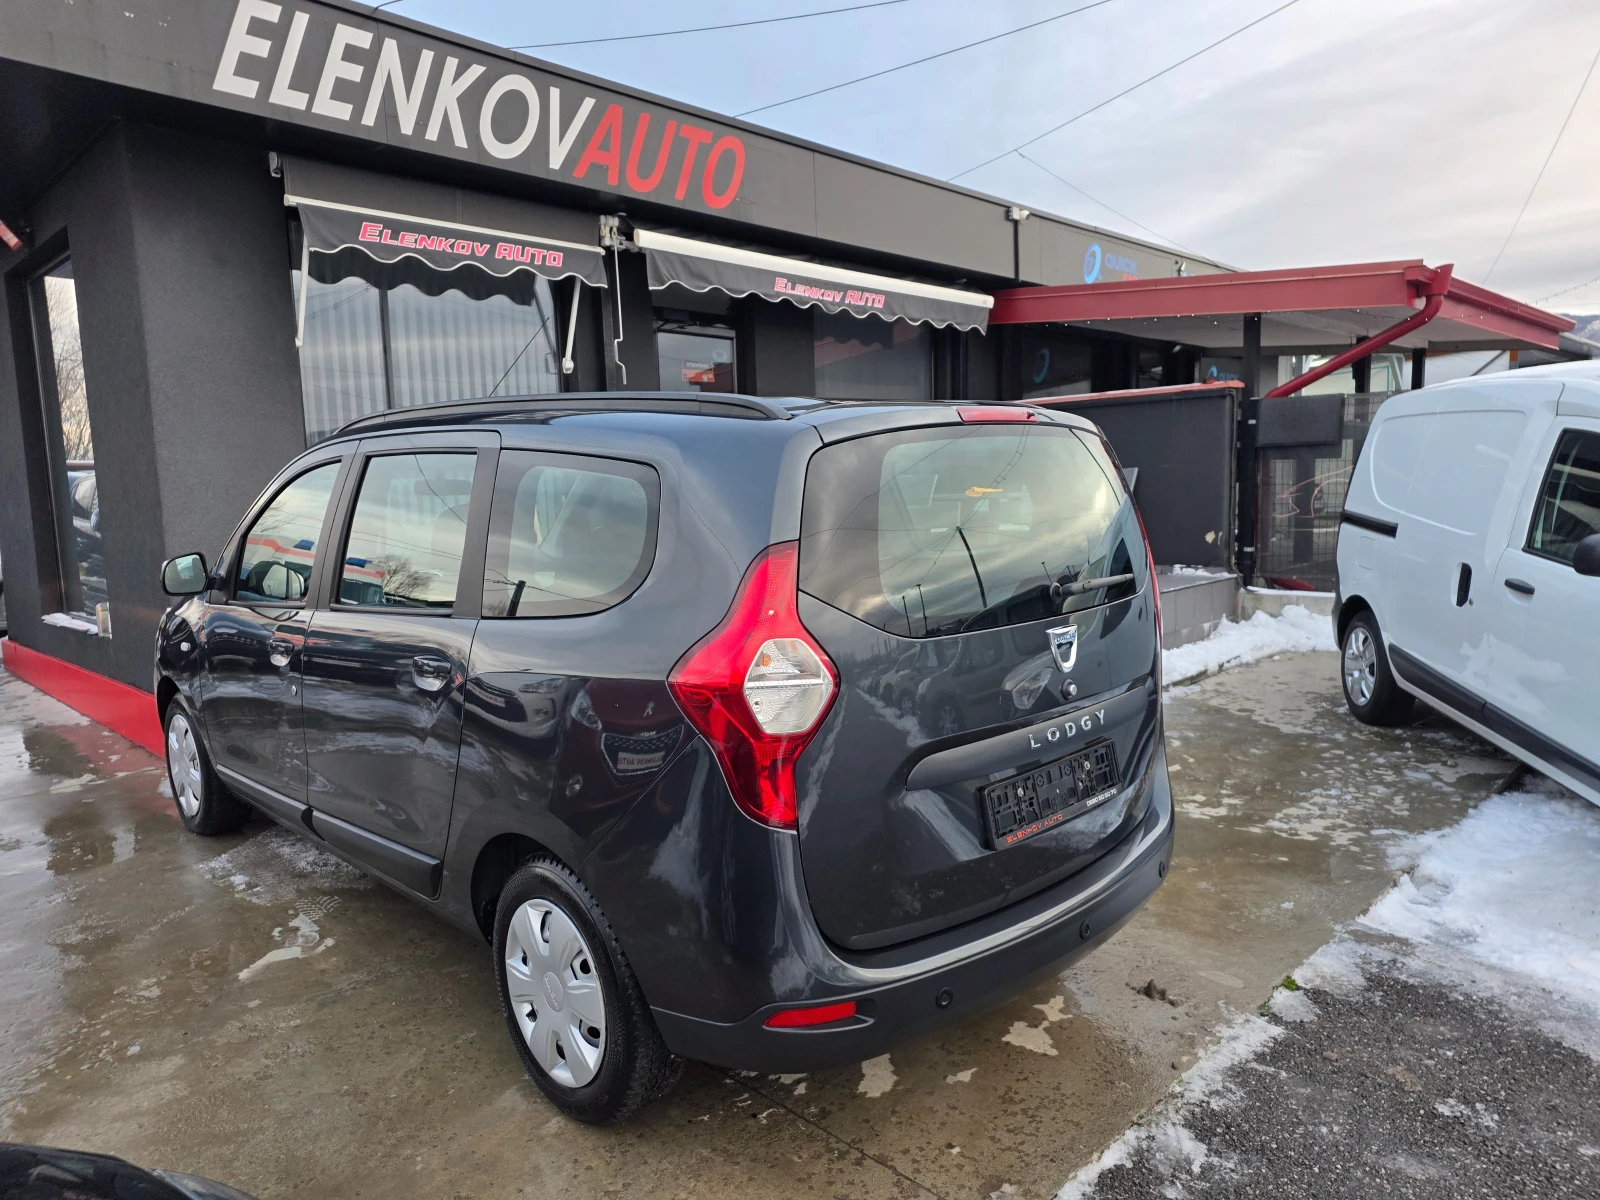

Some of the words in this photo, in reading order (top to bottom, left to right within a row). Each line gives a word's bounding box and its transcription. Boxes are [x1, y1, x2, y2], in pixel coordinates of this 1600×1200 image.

[359, 222, 490, 257] ELENKOV
[495, 242, 563, 267] AUTO
[774, 277, 843, 303] ELENKOV
[845, 290, 885, 308] AUTO
[1028, 709, 1105, 750] LODGY
[1044, 814, 1063, 826] AUTO
